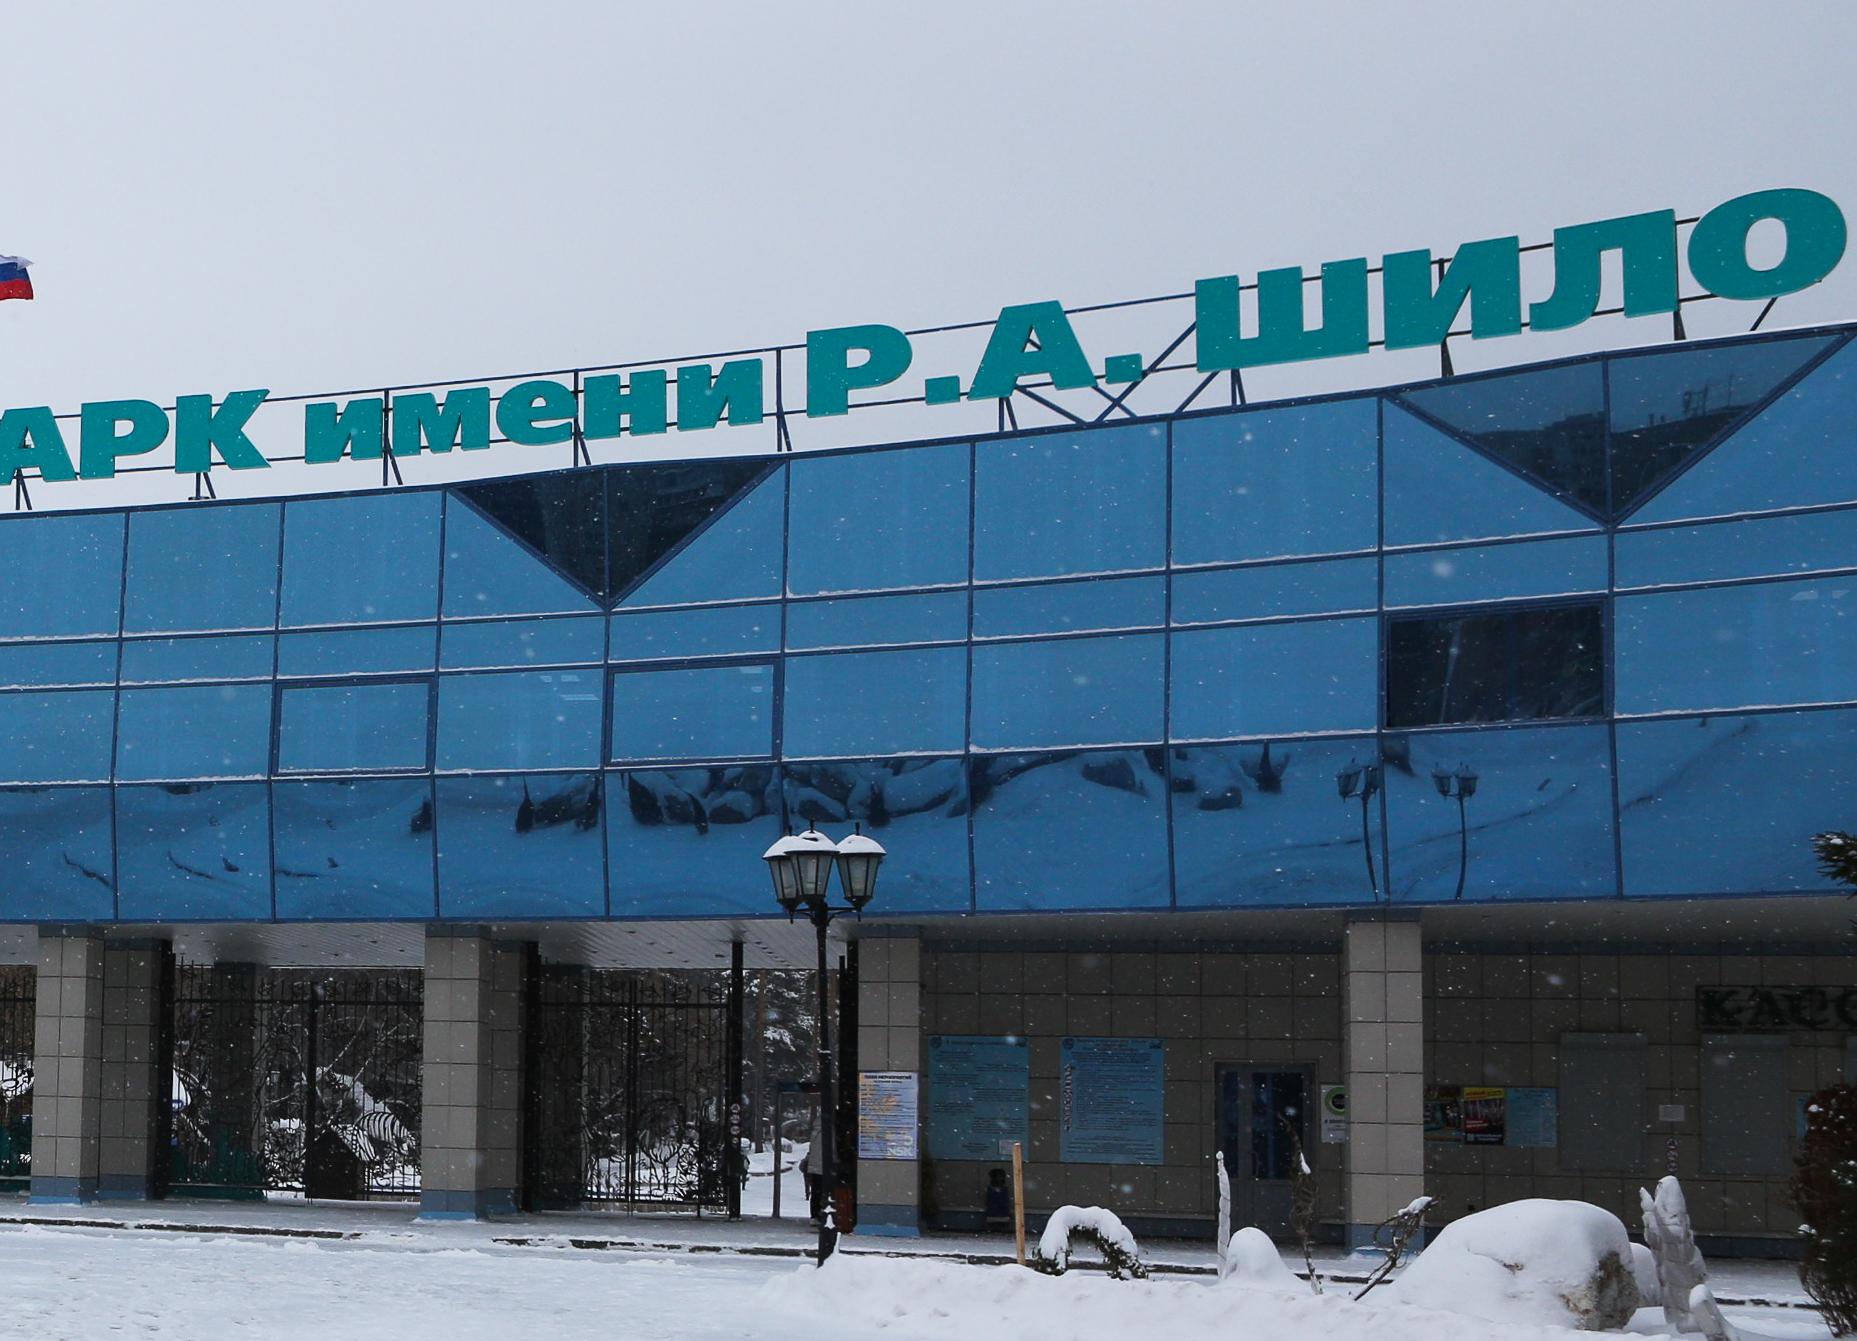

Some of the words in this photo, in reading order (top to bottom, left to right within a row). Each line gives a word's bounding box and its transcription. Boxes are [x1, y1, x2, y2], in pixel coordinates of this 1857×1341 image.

[304, 358, 763, 464] имени
[806, 299, 1143, 418] Р.А.
[1195, 188, 1847, 373] ШИЛО
